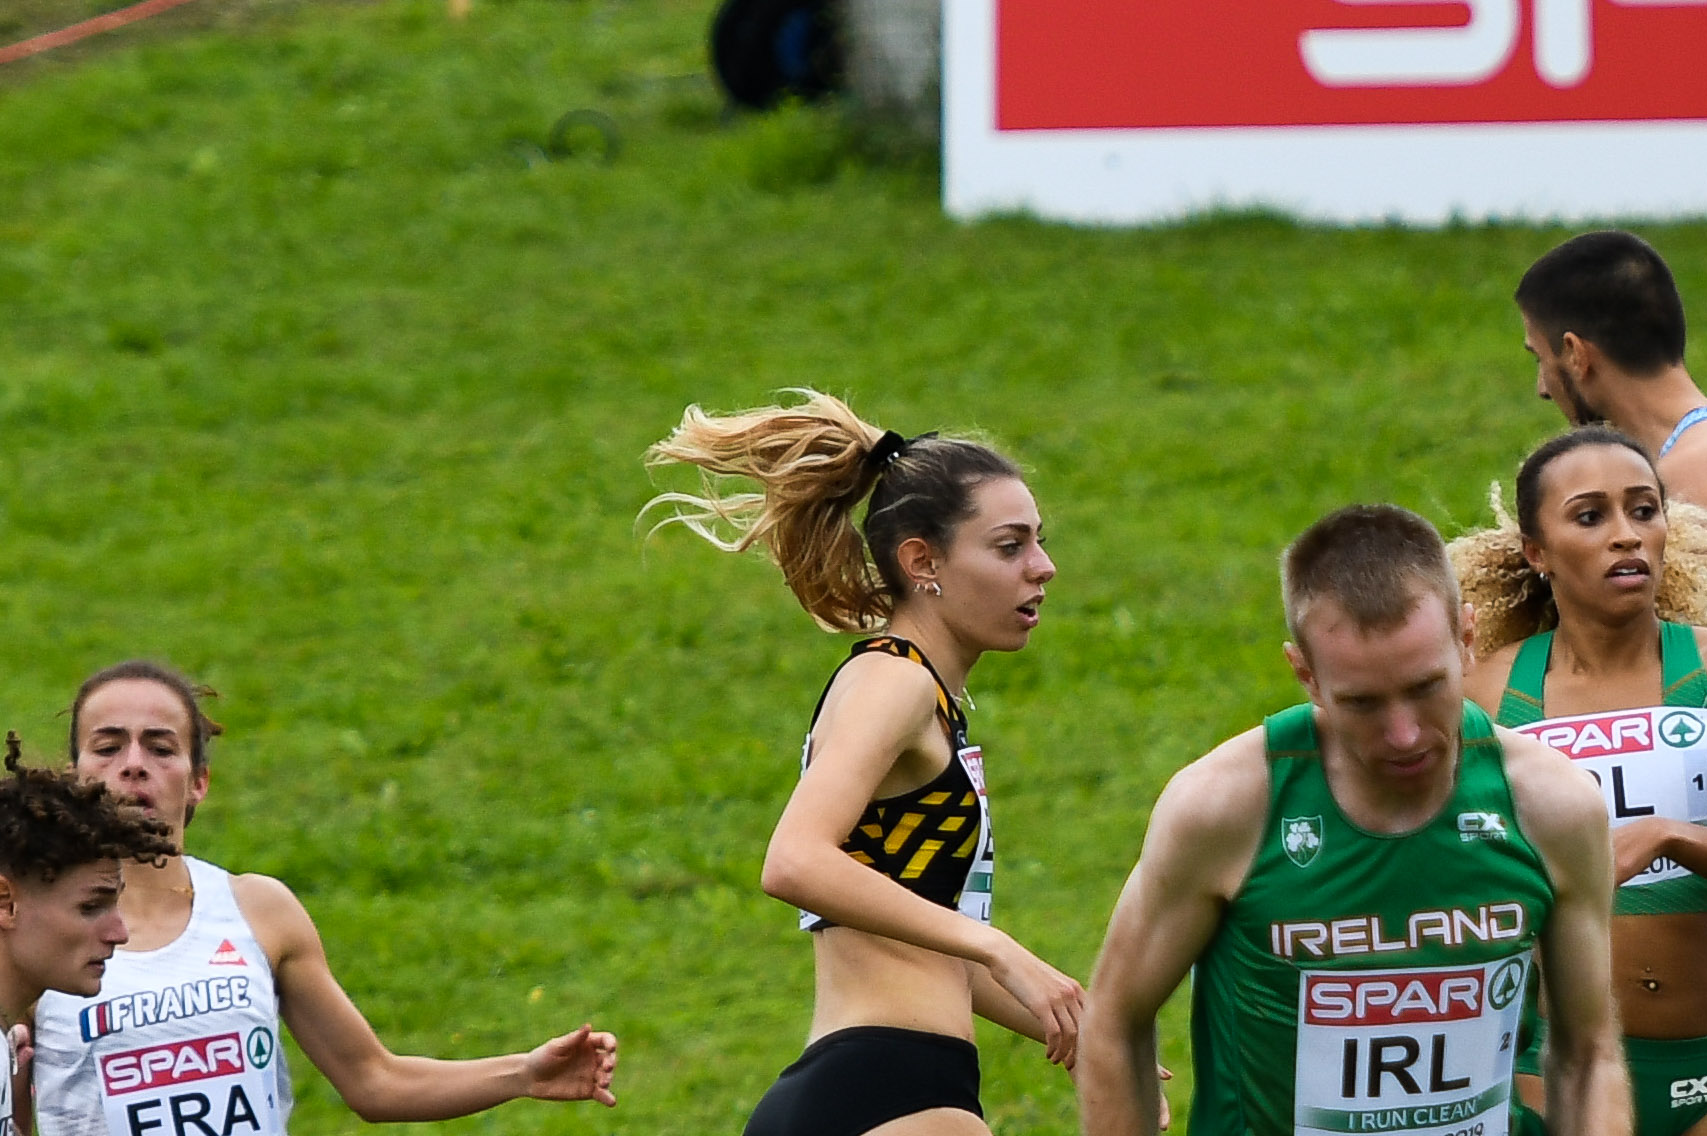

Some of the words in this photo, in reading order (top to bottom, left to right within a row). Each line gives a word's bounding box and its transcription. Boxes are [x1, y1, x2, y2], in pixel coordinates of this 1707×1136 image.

[1517, 717, 1650, 754] PAR
[1692, 774, 1704, 791] 1
[1457, 812, 1504, 831] CX
[1460, 831, 1507, 842] SPORT
[1270, 902, 1525, 958] IRELAND
[108, 976, 251, 1032] FRANCE
[1310, 976, 1479, 1020] SPAR
[1499, 1031, 1510, 1052] 2
[105, 1038, 242, 1090] SPAR
[1341, 1033, 1471, 1099] IRL
[1348, 1113, 1354, 1129] I
[1361, 1109, 1408, 1129] RUN
[1413, 1100, 1477, 1125] CLEAN
